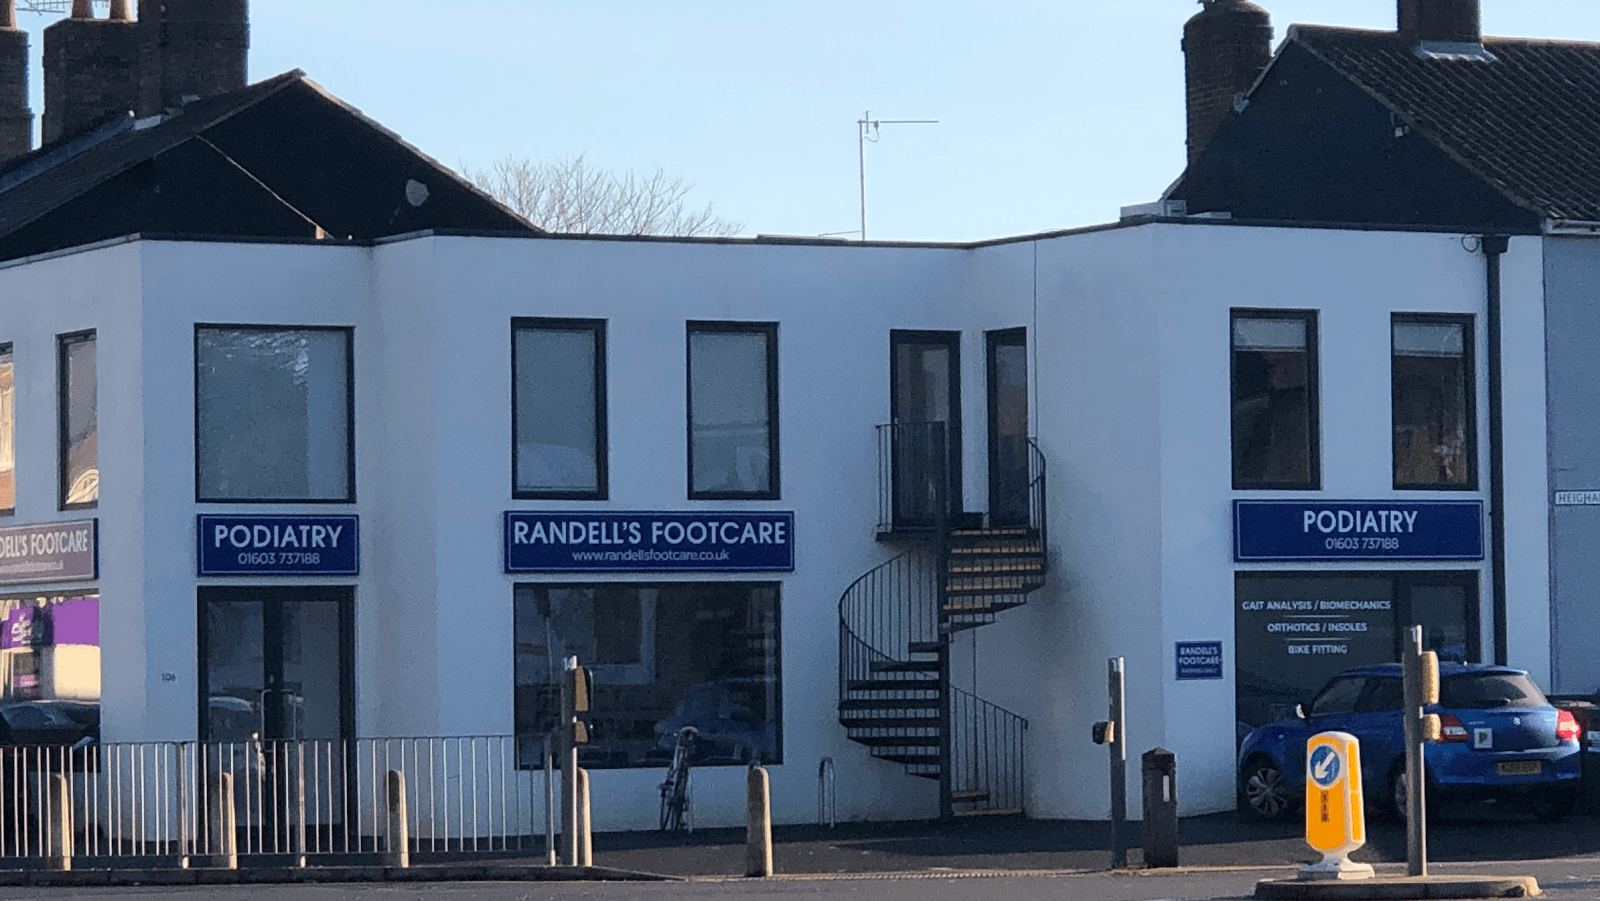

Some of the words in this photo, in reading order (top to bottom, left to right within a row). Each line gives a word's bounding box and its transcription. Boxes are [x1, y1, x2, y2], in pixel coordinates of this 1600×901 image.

[1558, 493, 1600, 503] HEIGHA
[1303, 510, 1418, 533] PODIATRY
[214, 524, 343, 548] PODIATRY
[514, 521, 642, 544] RANDELL'S
[651, 521, 786, 545] FOOTCARE
[30, 529, 89, 556] FOOTCARE
[1325, 537, 1360, 550] 01603
[1361, 537, 1400, 550] 737188
[238, 552, 276, 565] 01603
[279, 552, 321, 565] 737188
[571, 549, 730, 561] www.randellsfootcare.co.uk
[1242, 600, 1264, 611] GAIT
[1266, 600, 1313, 611] ANALYSIS
[1319, 600, 1392, 611] BIOMECHANICS
[1267, 622, 1321, 632] ORTHOTICS
[1328, 622, 1368, 632] INSOLES
[1288, 644, 1311, 655] BIKE
[1312, 644, 1348, 655] FITTING
[1478, 731, 1489, 744] P
